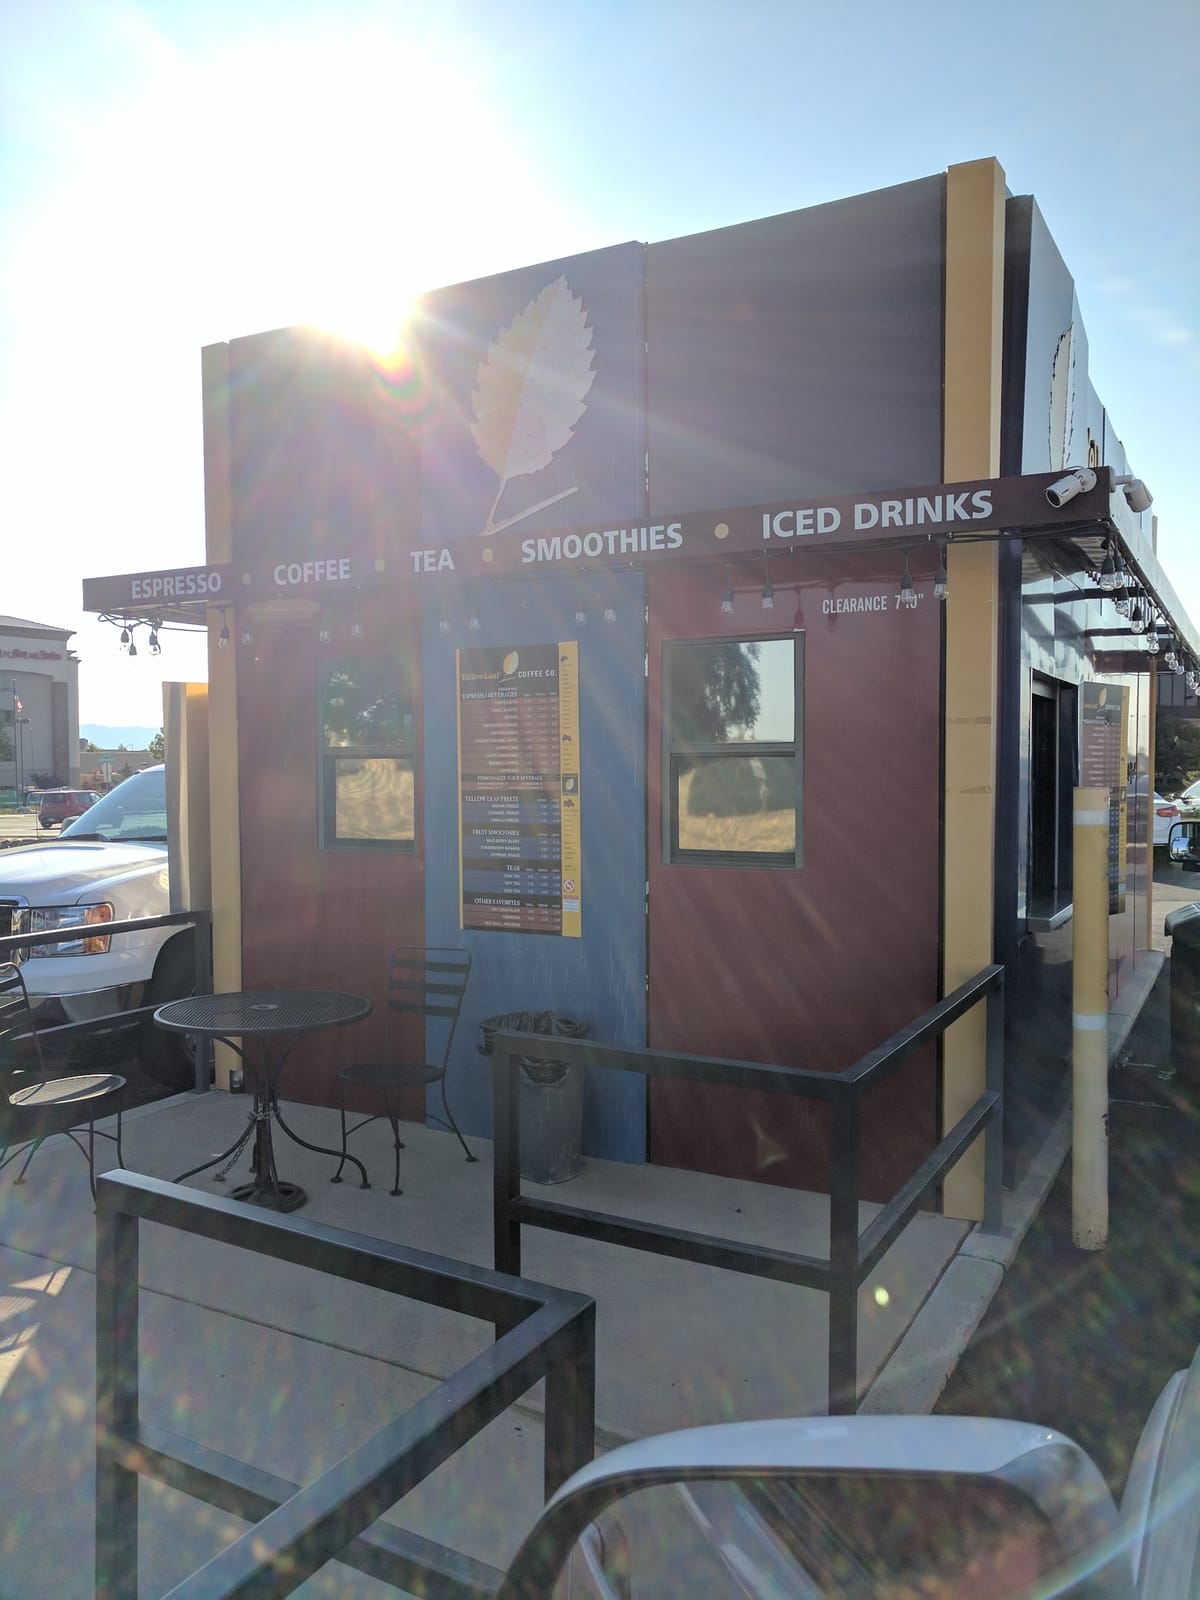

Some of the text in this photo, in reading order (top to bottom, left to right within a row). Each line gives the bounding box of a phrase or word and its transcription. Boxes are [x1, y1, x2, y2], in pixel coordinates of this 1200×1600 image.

[130, 489, 993, 600] ESPRESSO COFFEE TEA SMOOTHIES ICED DRINKS
[822, 595, 888, 615] CLEARANCE
[518, 670, 543, 678] COFFEE
